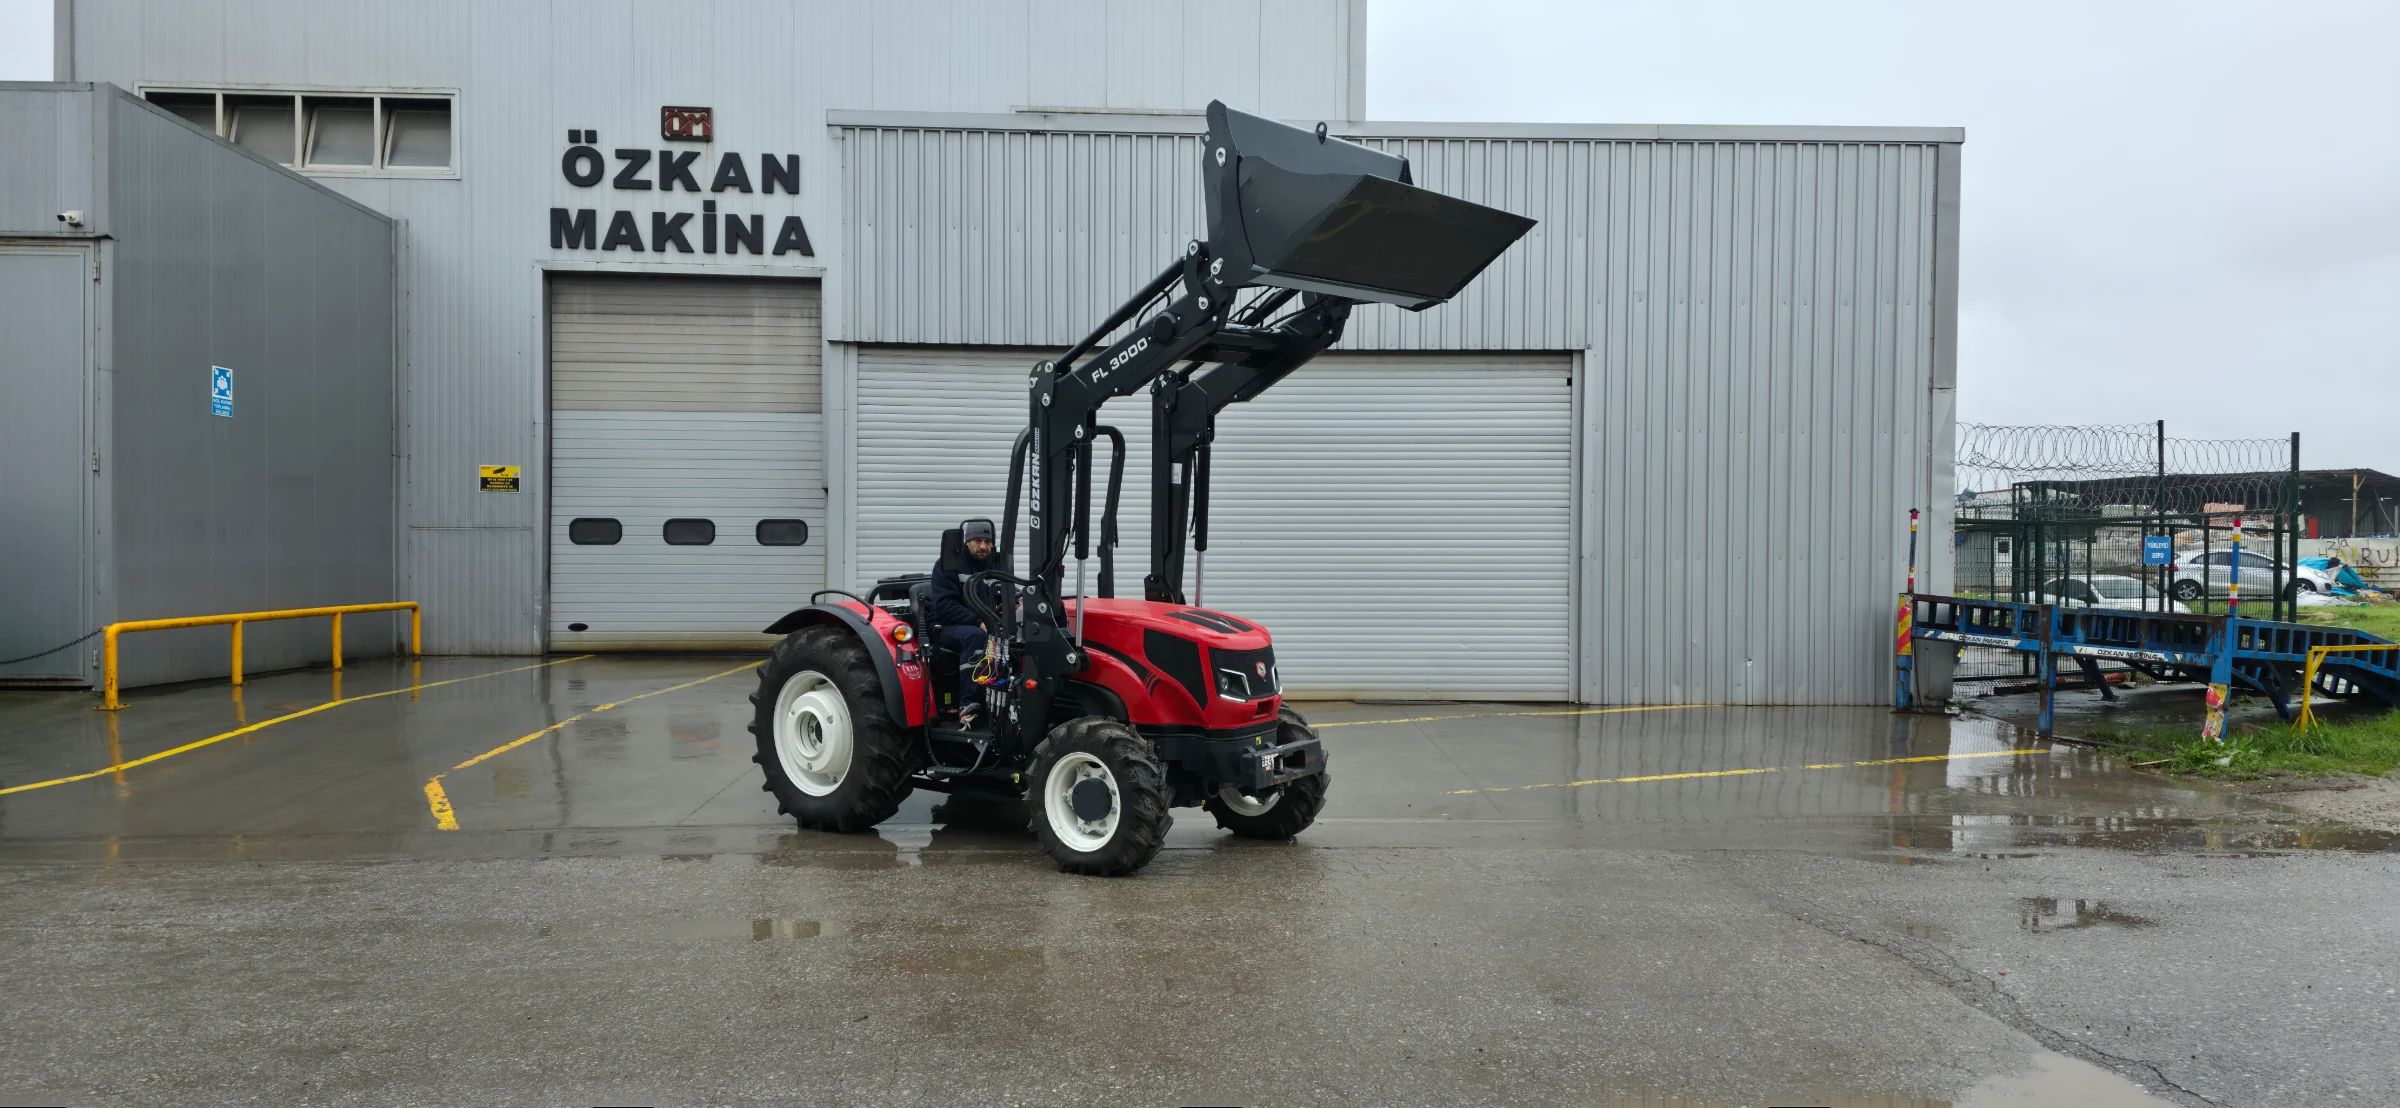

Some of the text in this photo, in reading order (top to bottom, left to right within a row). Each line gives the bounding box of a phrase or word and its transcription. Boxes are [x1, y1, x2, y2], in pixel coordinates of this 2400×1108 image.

[562, 129, 800, 194] ÖZKAN
[550, 200, 814, 256] MAKİNA
[1091, 337, 1148, 383] FL 3000
[1031, 453, 1040, 512] ÖZKAN
